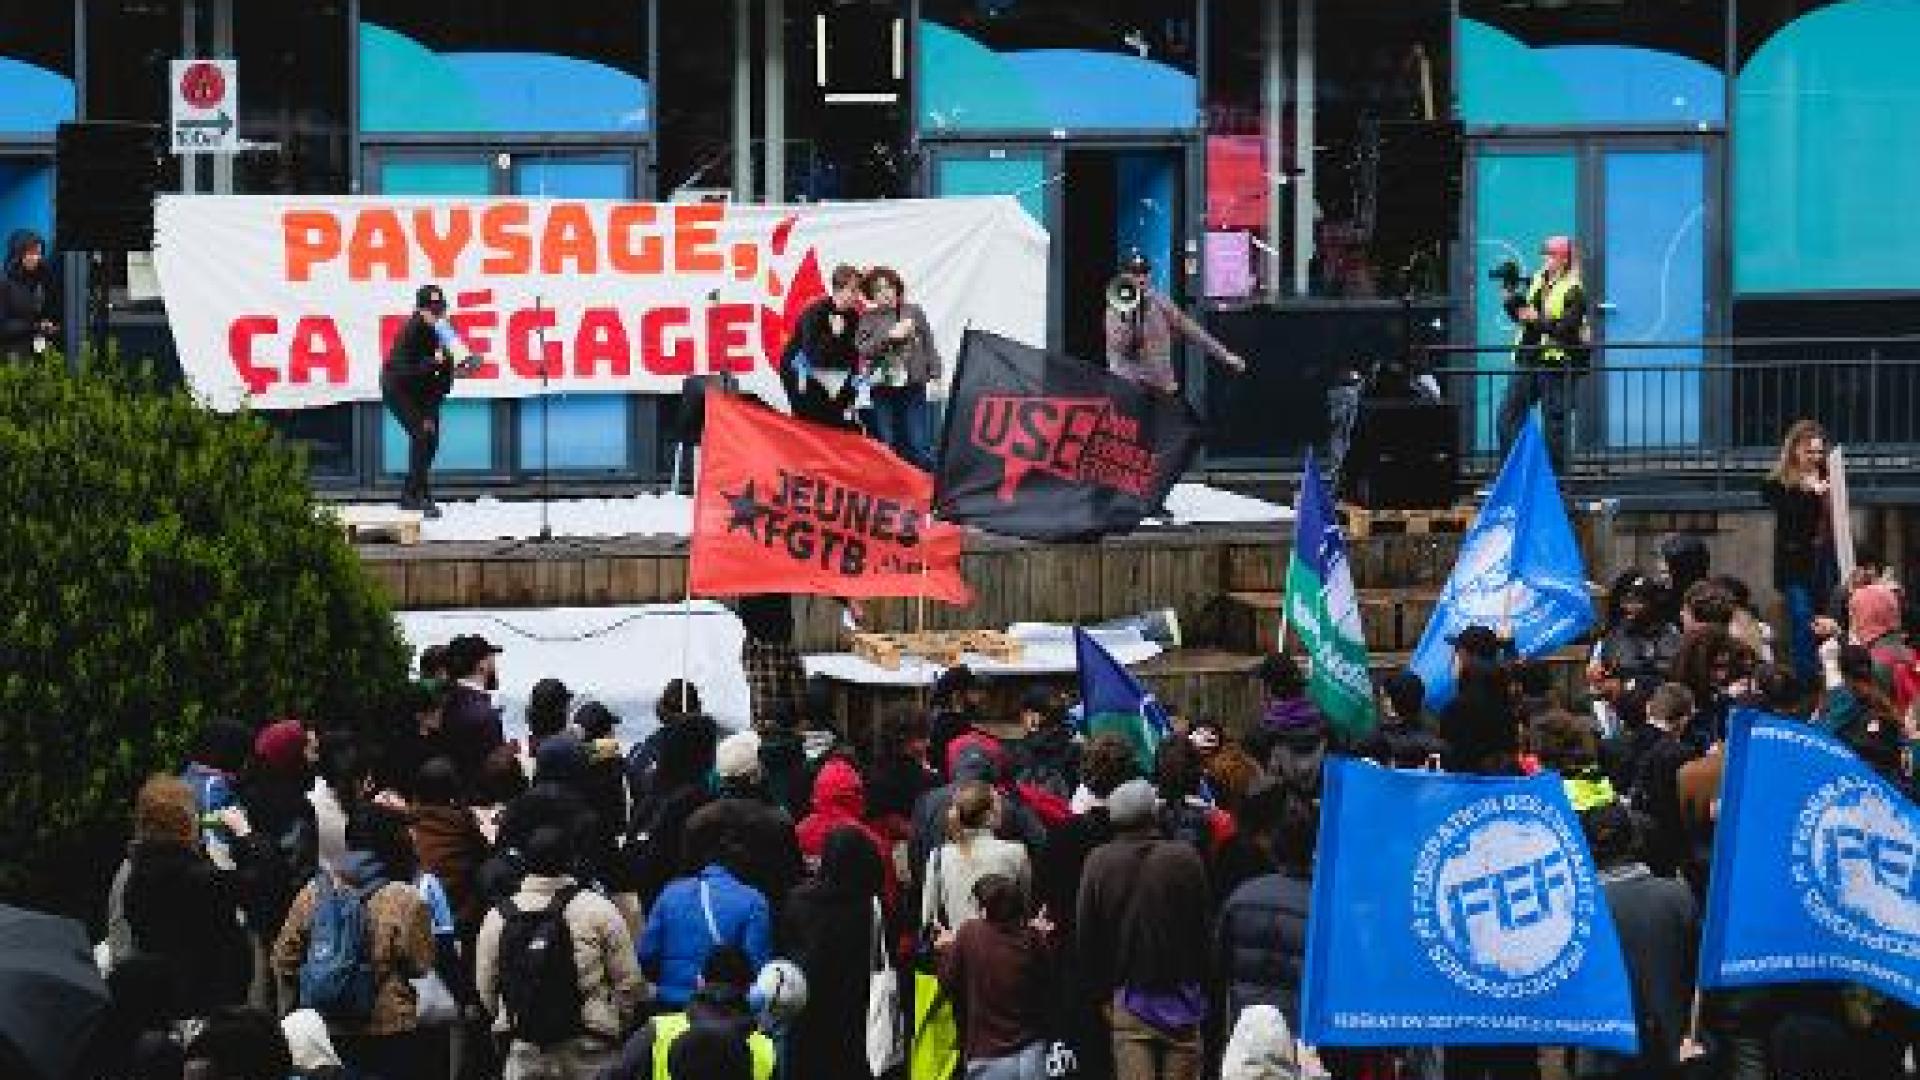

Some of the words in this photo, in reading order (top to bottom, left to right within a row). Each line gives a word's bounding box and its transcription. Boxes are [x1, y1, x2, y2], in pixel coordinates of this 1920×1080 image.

[283, 203, 758, 281] PAYSAGE,
[230, 314, 350, 394] ÇA
[980, 398, 1112, 470] USE
[763, 508, 867, 578] FGTB
[771, 468, 920, 547] JEUNES
[1822, 826, 1920, 898] FE
[1448, 851, 1565, 955] FEF
